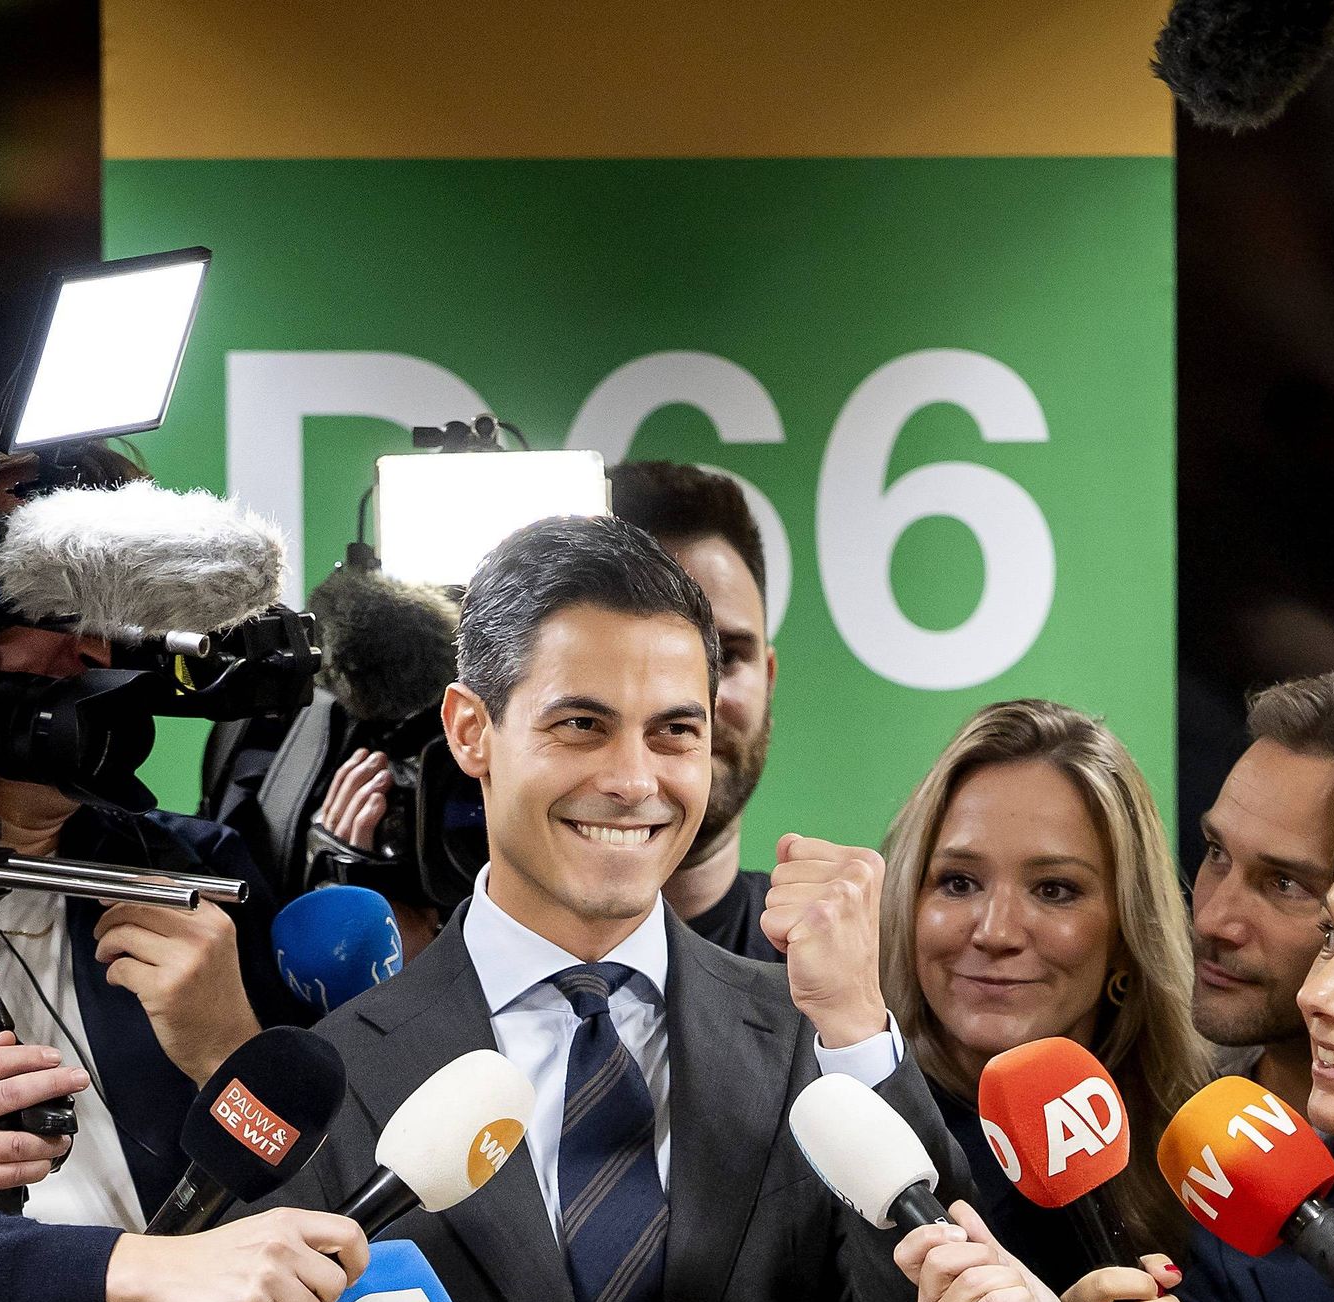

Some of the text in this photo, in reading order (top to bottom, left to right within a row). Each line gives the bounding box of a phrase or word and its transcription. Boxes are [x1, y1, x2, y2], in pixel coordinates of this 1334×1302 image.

[216, 1101, 281, 1156] DE WIT
[227, 1087, 288, 1146] PAUW &
[1043, 1076, 1122, 1177] AD
[1227, 1093, 1298, 1154] 1V
[1180, 1144, 1234, 1221] 1V
